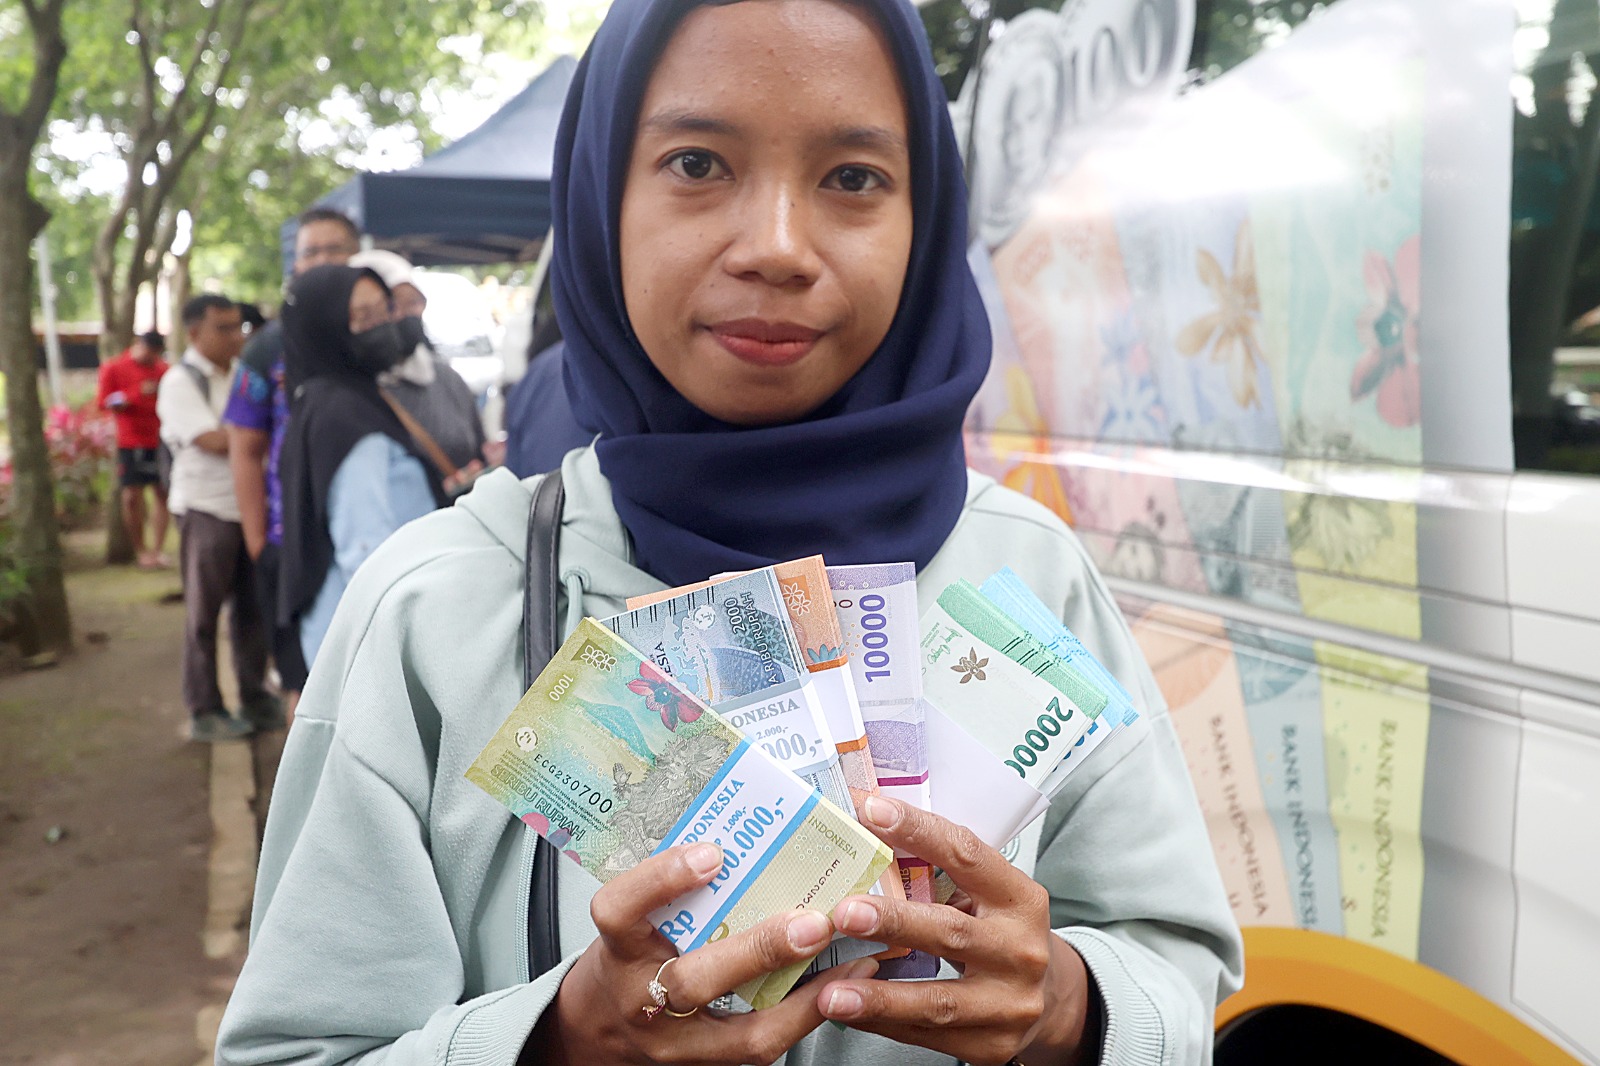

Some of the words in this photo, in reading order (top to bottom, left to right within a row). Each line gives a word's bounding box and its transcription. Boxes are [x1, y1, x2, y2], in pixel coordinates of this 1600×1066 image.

[724, 597, 747, 634] 2000
[740, 591, 763, 641] RUPIAH
[859, 594, 891, 683] 10000
[760, 640, 775, 673] RIBU
[549, 674, 574, 701] 1000
[730, 698, 801, 729] ONESIA
[756, 725, 789, 740] 2.000,-
[1281, 724, 1300, 793] BANK
[1375, 718, 1398, 791] BANK
[490, 764, 539, 803] SERIBU
[535, 798, 586, 841] RUPIAH
[534, 754, 613, 813] ECG230700
[681, 778, 745, 846] DONESIA
[723, 806, 747, 834] 1.000,-
[808, 815, 858, 860] INDONESIA
[1211, 715, 1233, 779] BANK
[1224, 784, 1269, 918] INDONESIA
[1286, 800, 1318, 931] INDONESI
[1371, 798, 1394, 938] INDONESIA
[658, 910, 697, 944] Rp
